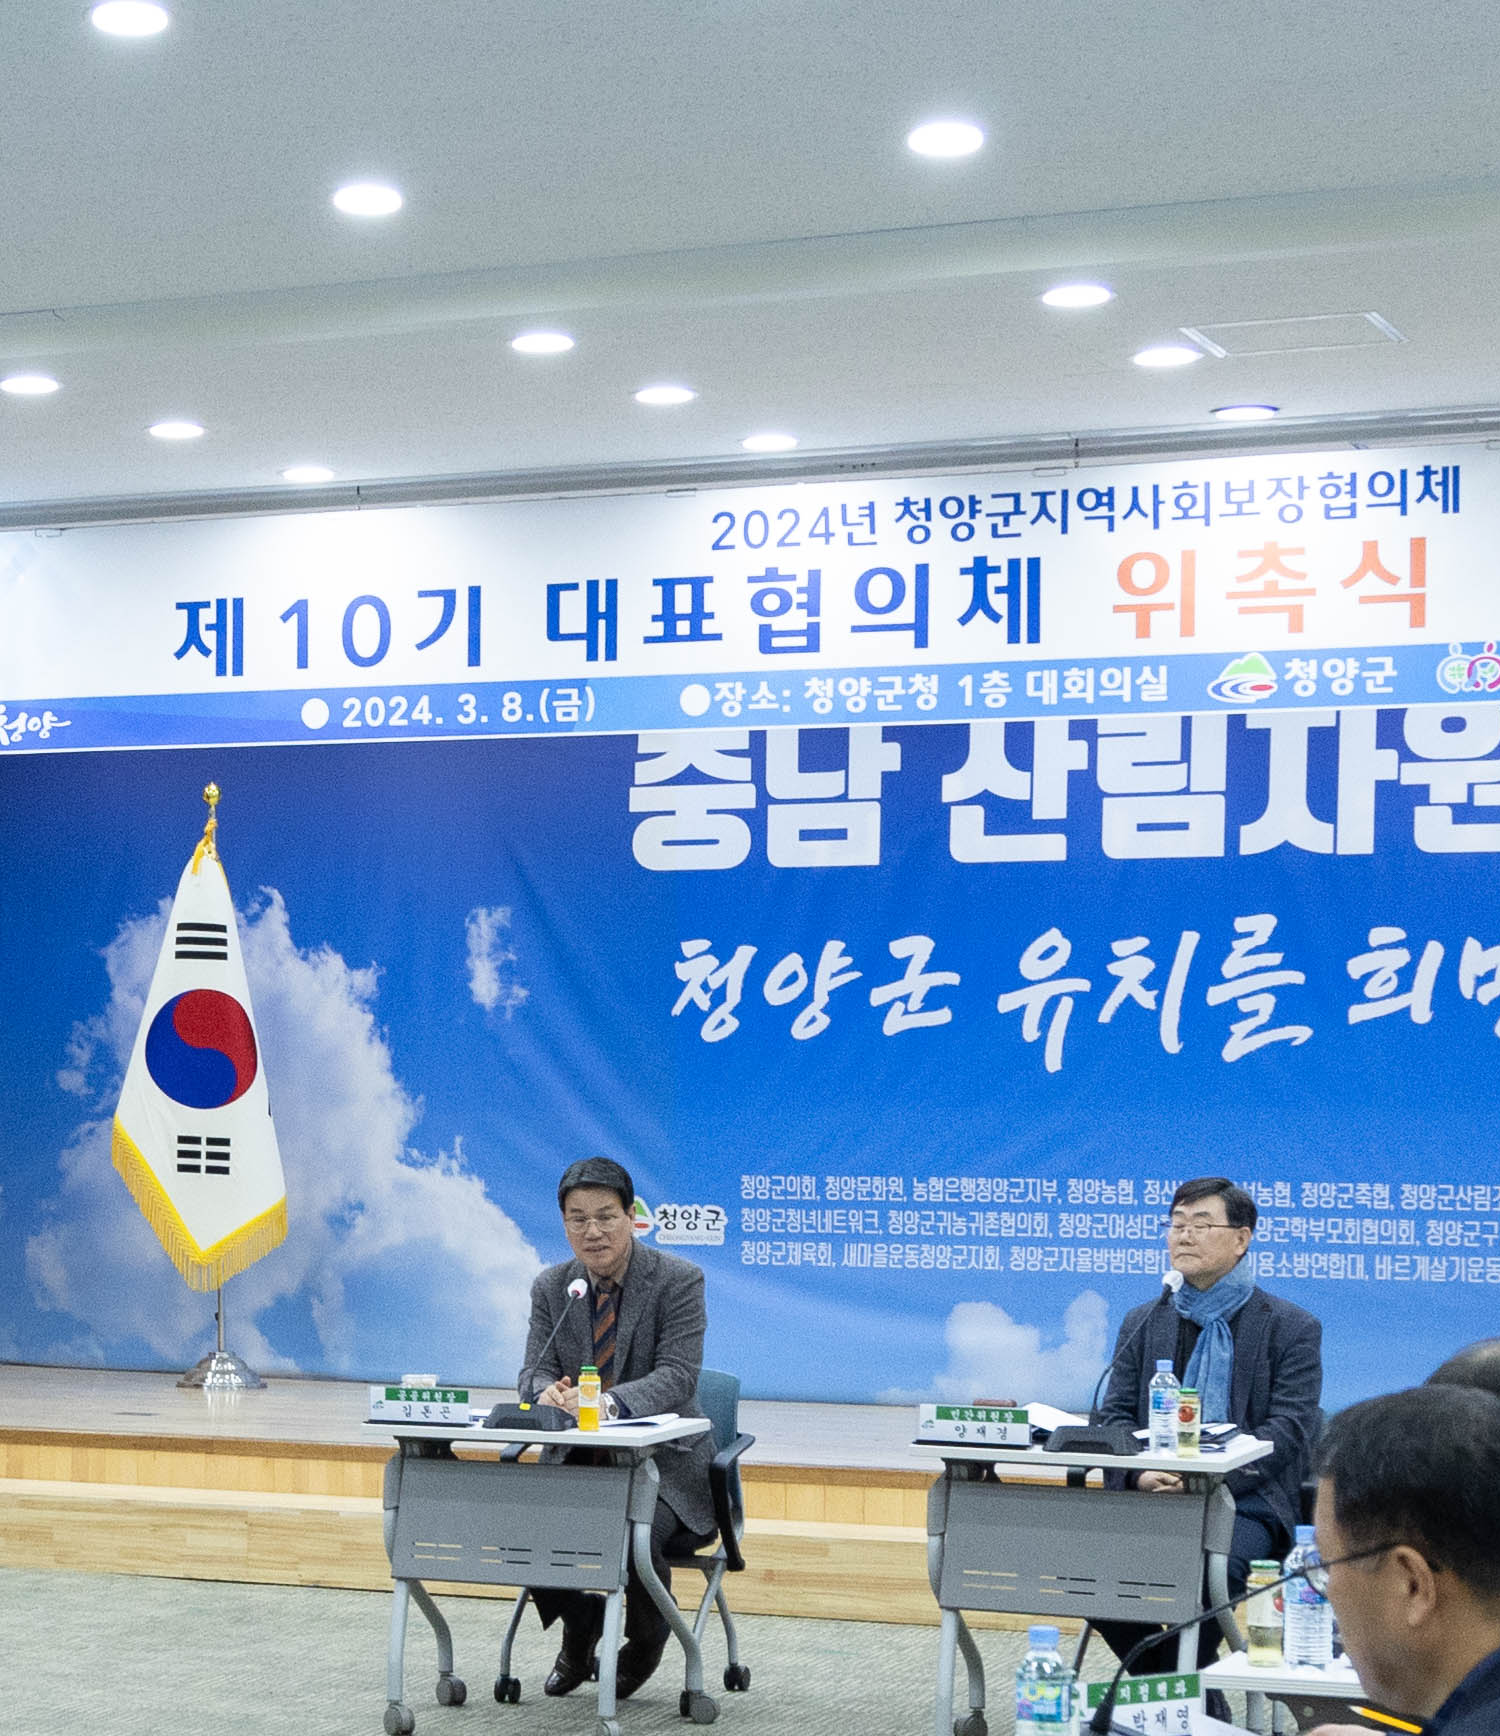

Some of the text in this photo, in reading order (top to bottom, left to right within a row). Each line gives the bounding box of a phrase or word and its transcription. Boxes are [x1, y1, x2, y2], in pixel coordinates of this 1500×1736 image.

[710, 464, 1462, 553] 2024년 청양군지역사회보장협의체
[545, 553, 1042, 662] 대표협의체
[1112, 535, 1428, 641] 위촉식
[714, 663, 1169, 718] 장소: 청양군청 1층 대회의실
[1283, 656, 1398, 697] 청양군
[341, 684, 597, 728] 2024. 3. 8.(금)
[629, 725, 901, 871] 충남
[670, 934, 962, 1046] 청양군
[995, 914, 1312, 1073] 유치를
[740, 1174, 820, 1201] 청양군의회,
[825, 1176, 907, 1203] 청양문화원,
[912, 1176, 1062, 1204] 농협은행청양군지부,
[1067, 1178, 1138, 1206] 청양농협,
[1143, 1179, 1183, 1205] 정산
[1301, 1181, 1395, 1211] 청양군축협,
[658, 1208, 725, 1231] 청양군
[740, 1207, 883, 1236] 청양군청년네트워크,
[887, 1210, 1053, 1239] 청양군귀농귀촌협의회,
[1250, 1215, 1420, 1246] 양군학부모회협의회,
[740, 1240, 837, 1268] 청양군체육회,
[841, 1242, 1004, 1272] 새마을운동청양군지회,
